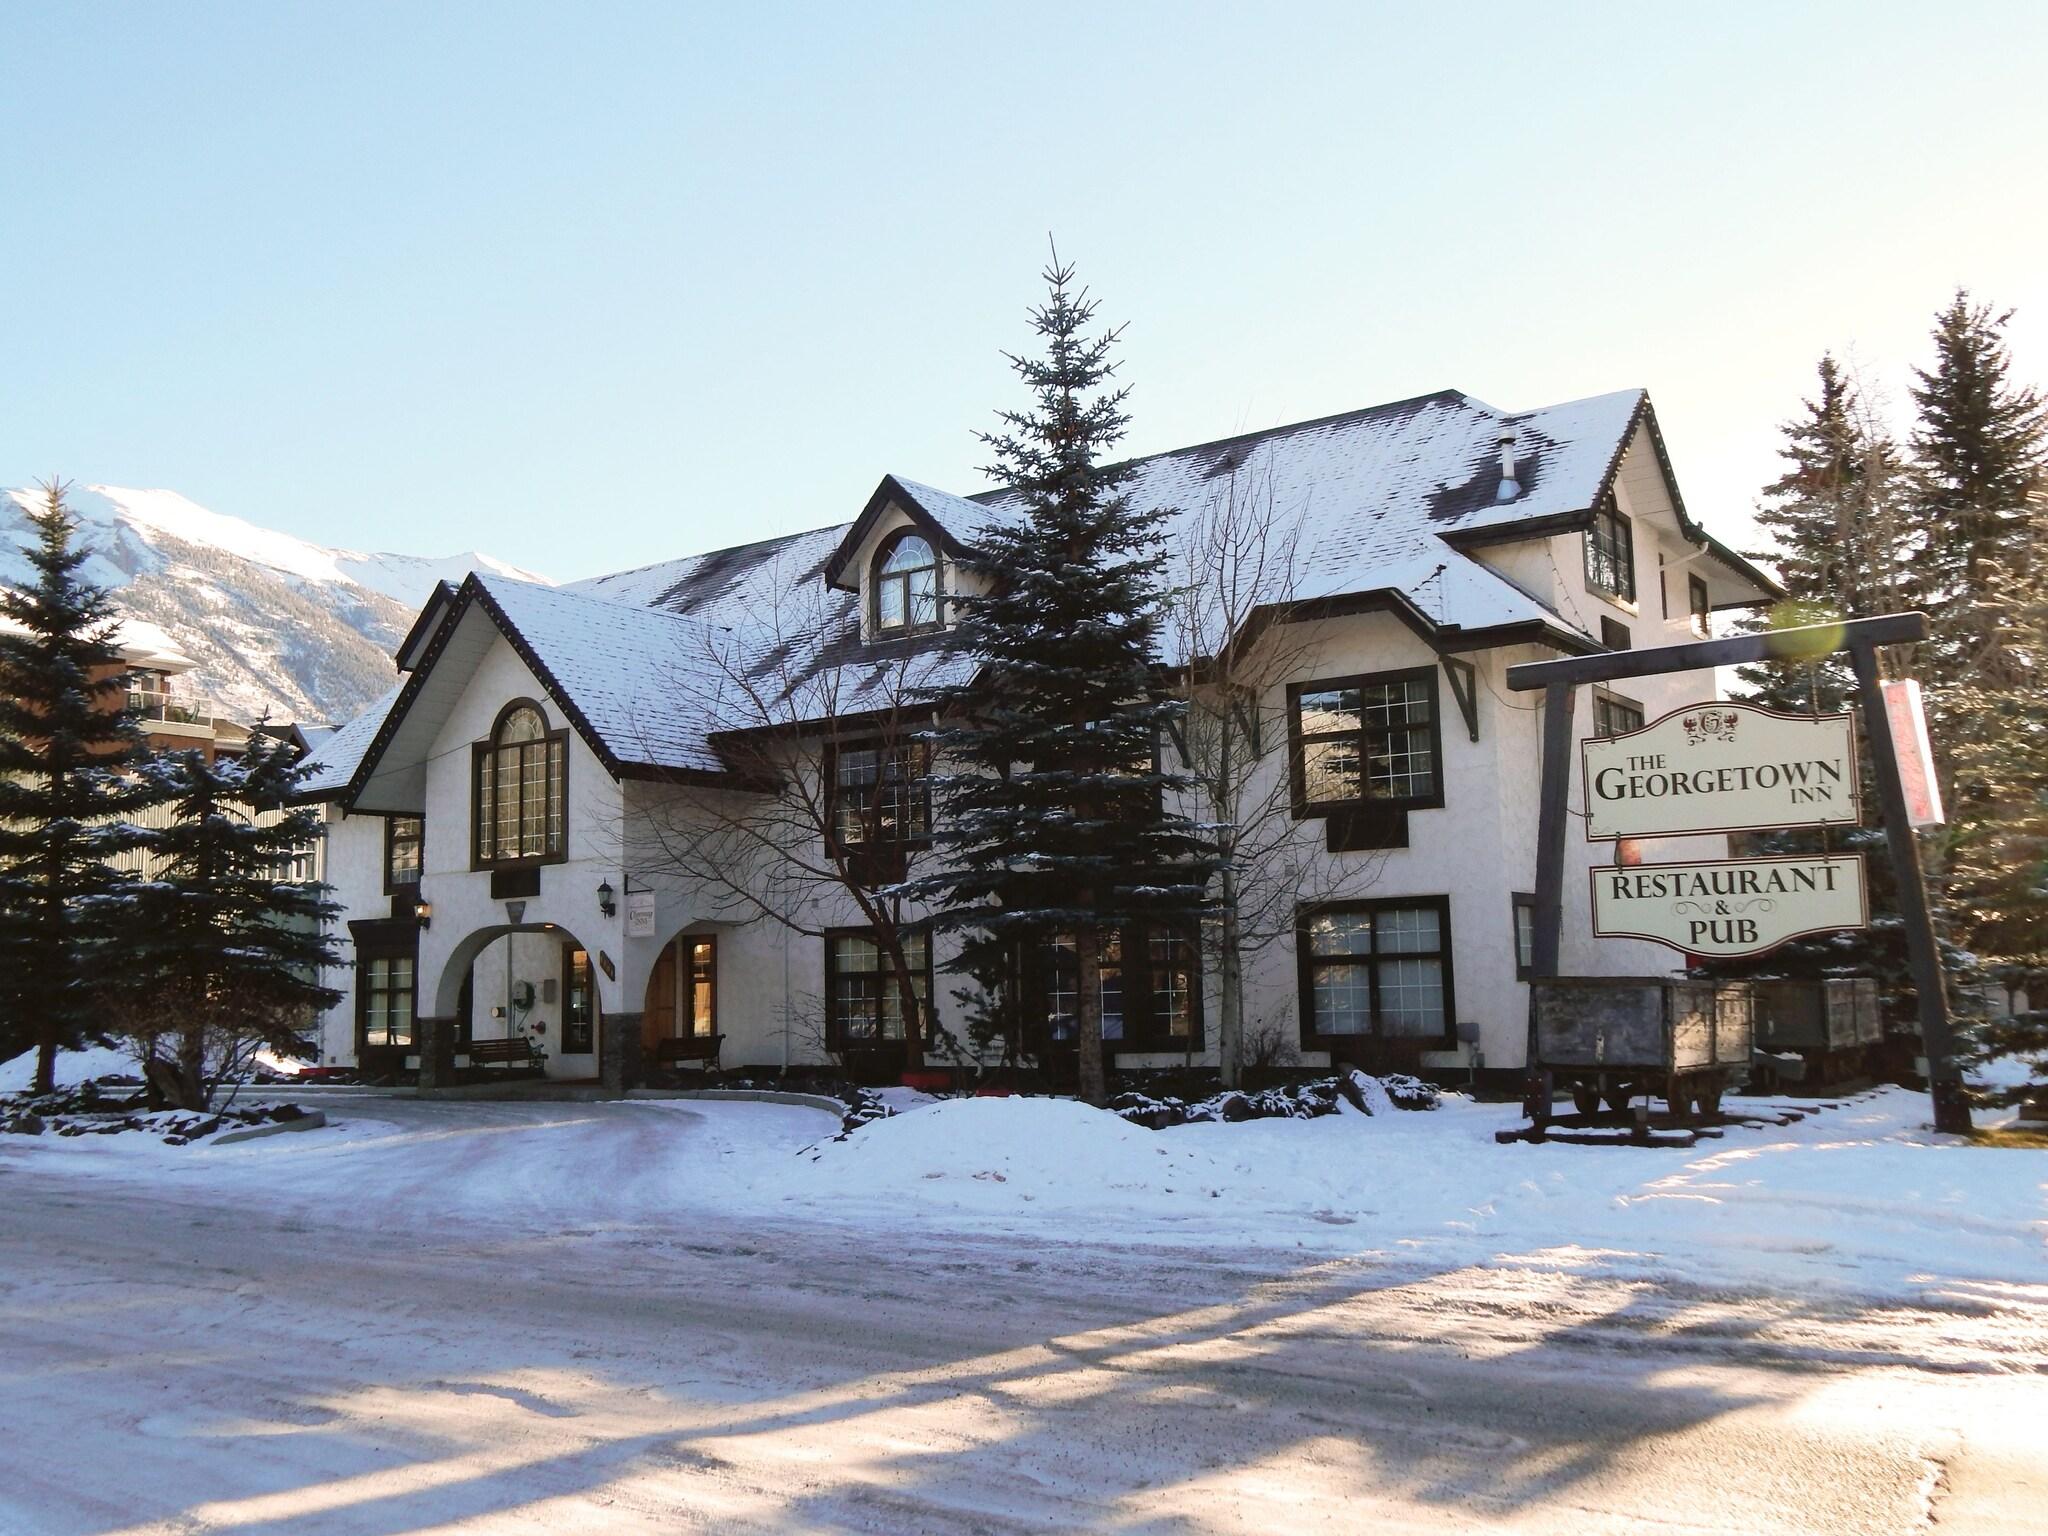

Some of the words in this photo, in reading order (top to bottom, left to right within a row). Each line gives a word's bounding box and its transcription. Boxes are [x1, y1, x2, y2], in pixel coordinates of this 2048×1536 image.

[1626, 754, 1667, 771] THE
[1595, 759, 1841, 800] GEORGETOWN
[1790, 786, 1832, 804] INN
[1611, 866, 1841, 899] RESTAURANT
[1715, 900, 1731, 915] &
[1689, 919, 1758, 944] PUB
